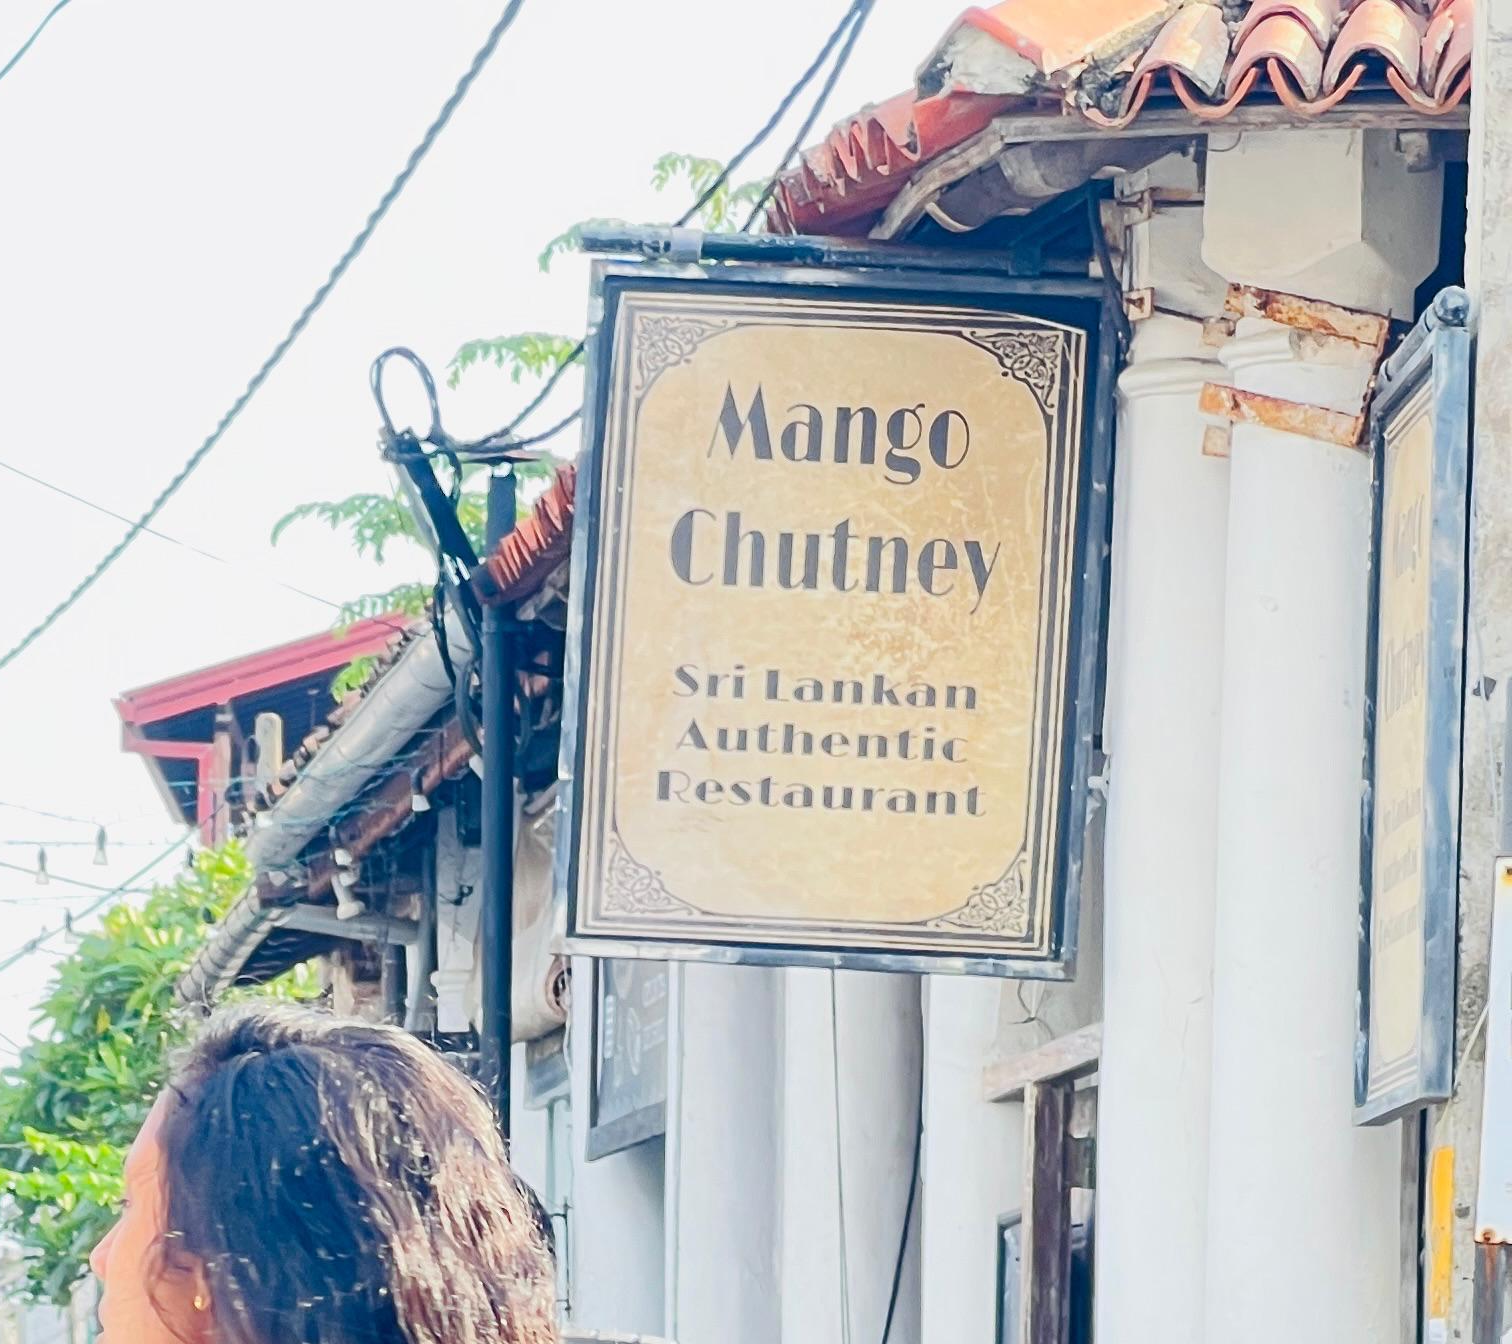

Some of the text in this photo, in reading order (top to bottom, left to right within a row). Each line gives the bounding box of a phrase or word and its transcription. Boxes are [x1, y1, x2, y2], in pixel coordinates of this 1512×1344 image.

[707, 381, 970, 486] Mango
[670, 508, 1002, 615] Chutney
[672, 663, 978, 711] Sri Lankan
[675, 718, 970, 765] Authentic
[656, 769, 987, 818] Restaurant
